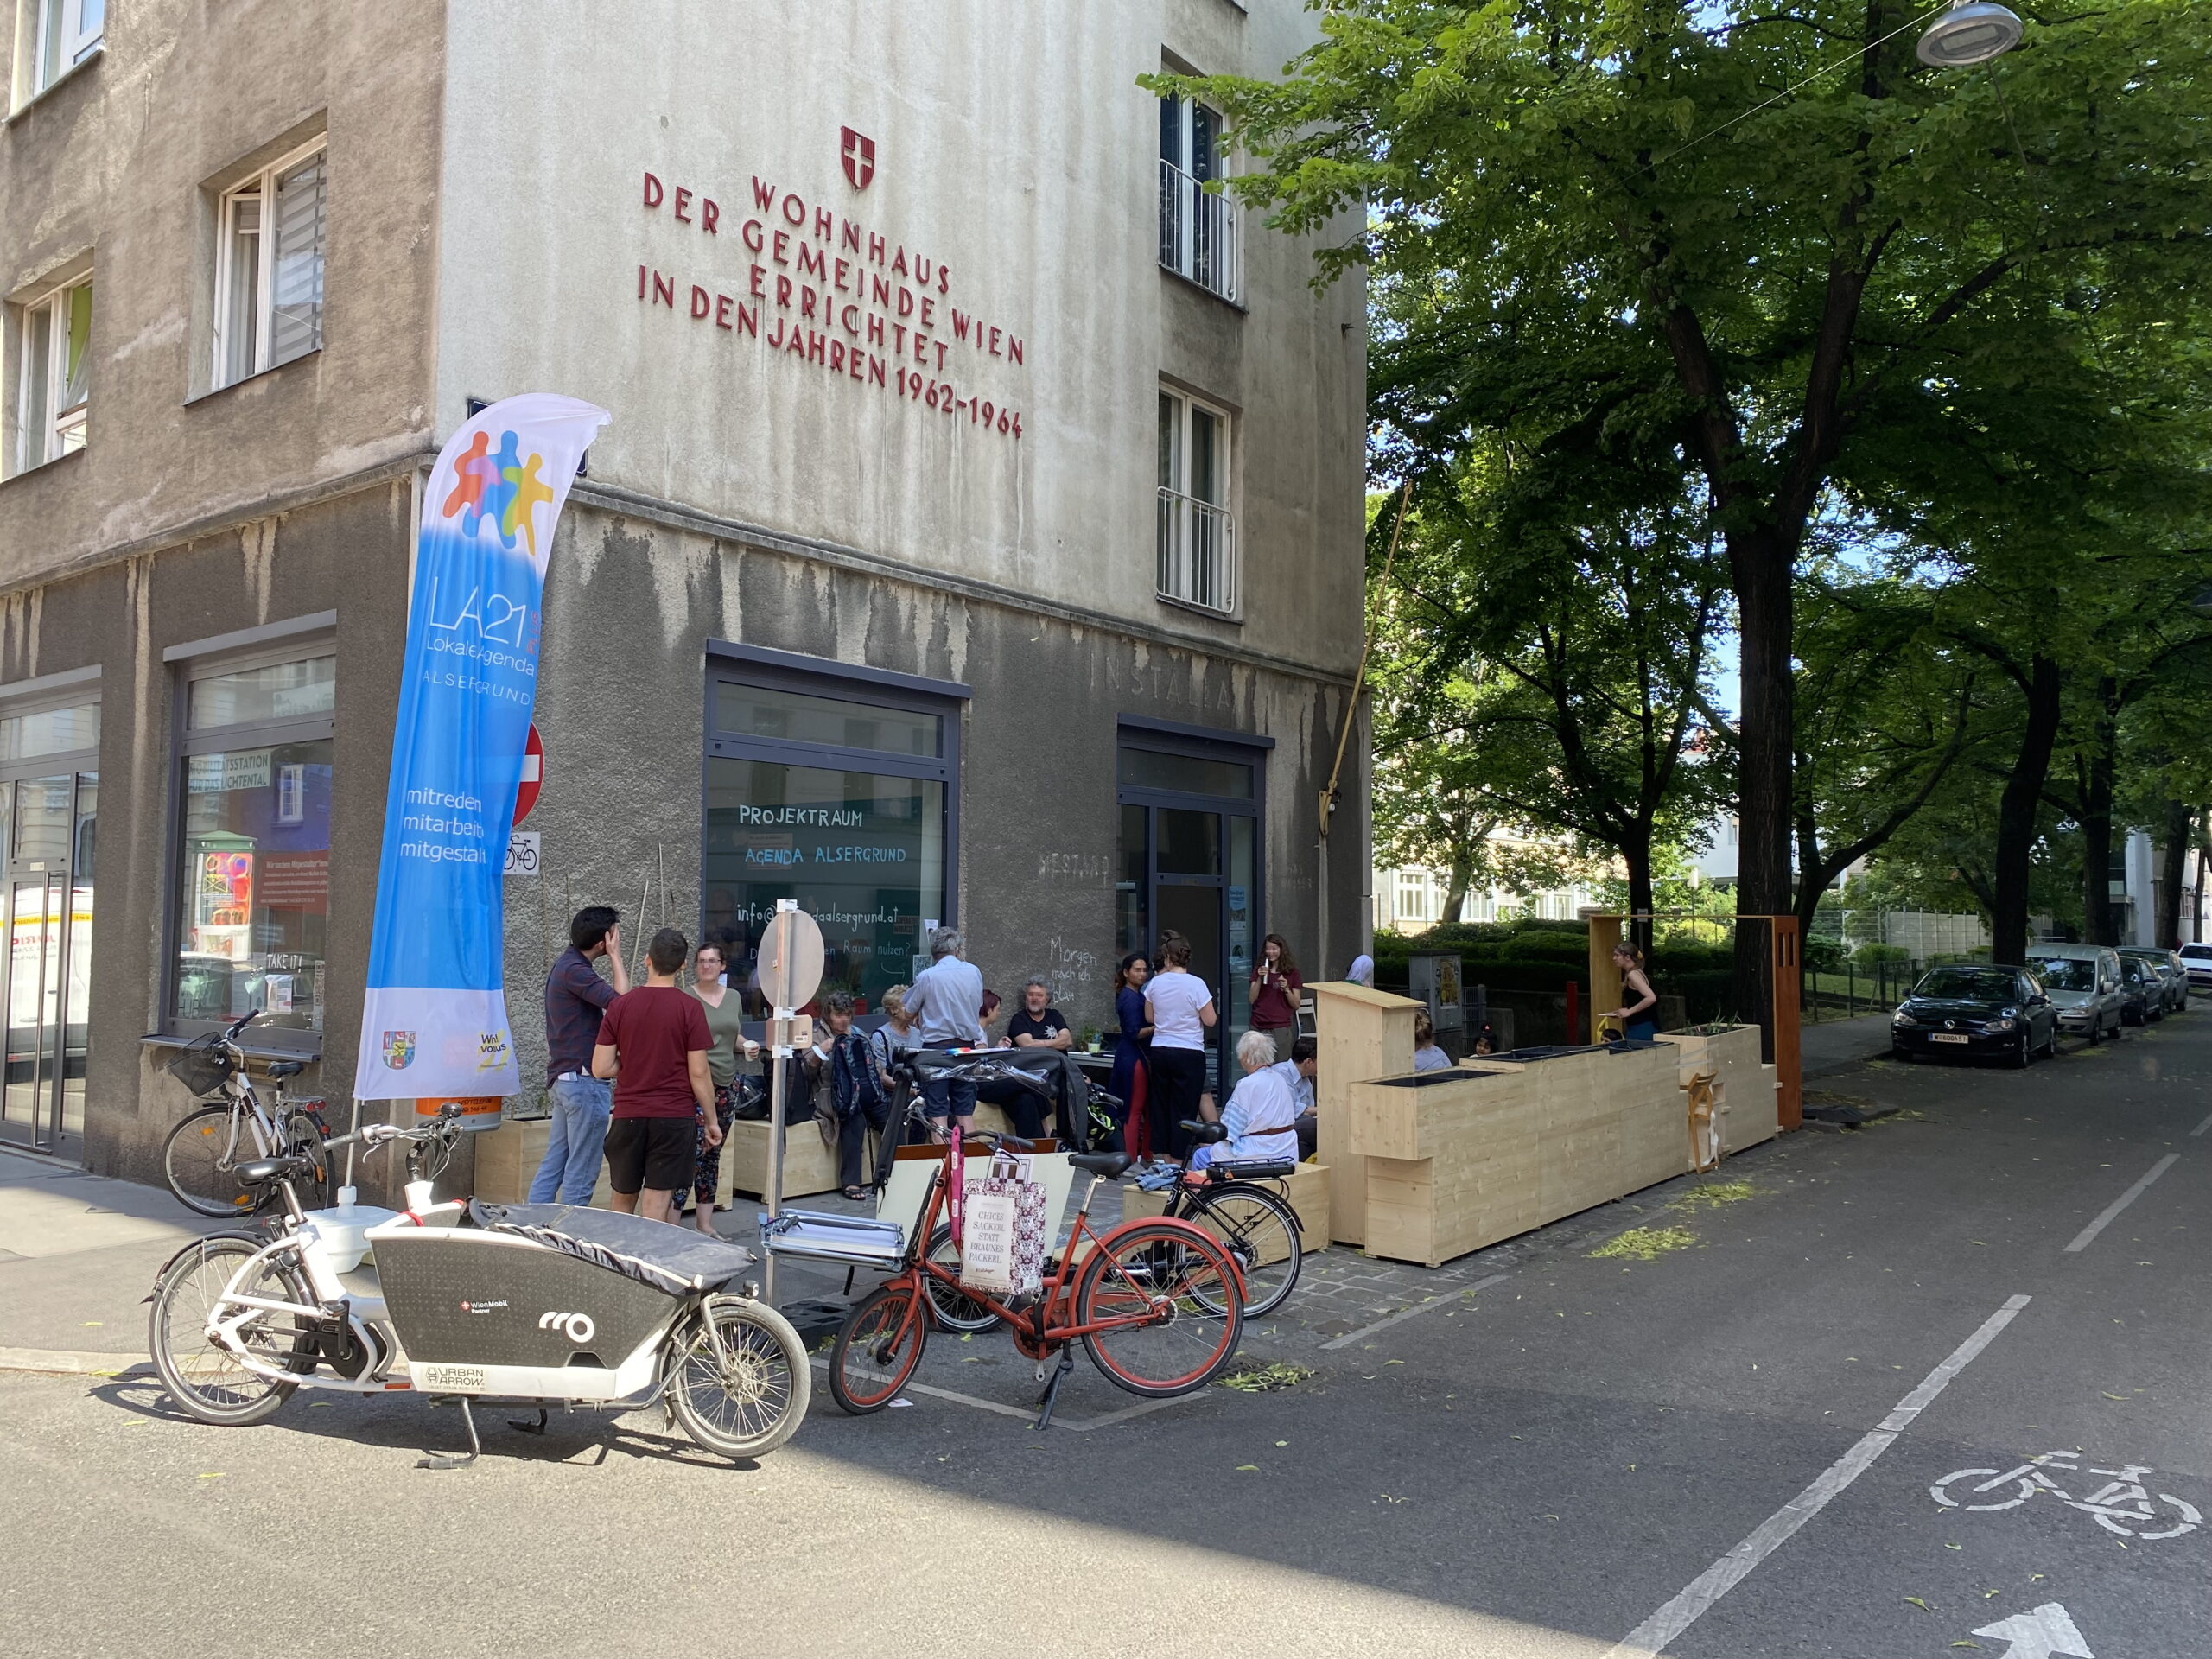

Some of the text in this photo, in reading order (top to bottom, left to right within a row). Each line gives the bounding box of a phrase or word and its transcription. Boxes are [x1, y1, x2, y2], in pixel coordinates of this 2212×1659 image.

[752, 175, 950, 295] WOHNHAUS
[644, 172, 1023, 365] DER GEMEINDE WIEN
[750, 264, 949, 371] ERRICHTET
[638, 264, 1023, 439] IN DEN JAHREN 1962-1964
[430, 576, 526, 648] LA21
[407, 788, 481, 813] mitreden
[739, 804, 862, 827] PROJEKTRAUM
[745, 847, 804, 866] AGENDA
[815, 846, 906, 863] ALSERGRUND
[843, 940, 871, 954] Raum
[1051, 935, 1097, 967] Morgen
[267, 954, 302, 973] TAKE IT!
[978, 1211, 1004, 1221] CHICES
[973, 1221, 1005, 1232] SACKERL
[970, 1242, 1004, 1253] BRAUNES
[978, 1232, 1000, 1243] STATT
[470, 1300, 508, 1308] WienMobil
[437, 1367, 484, 1377] URBAN
